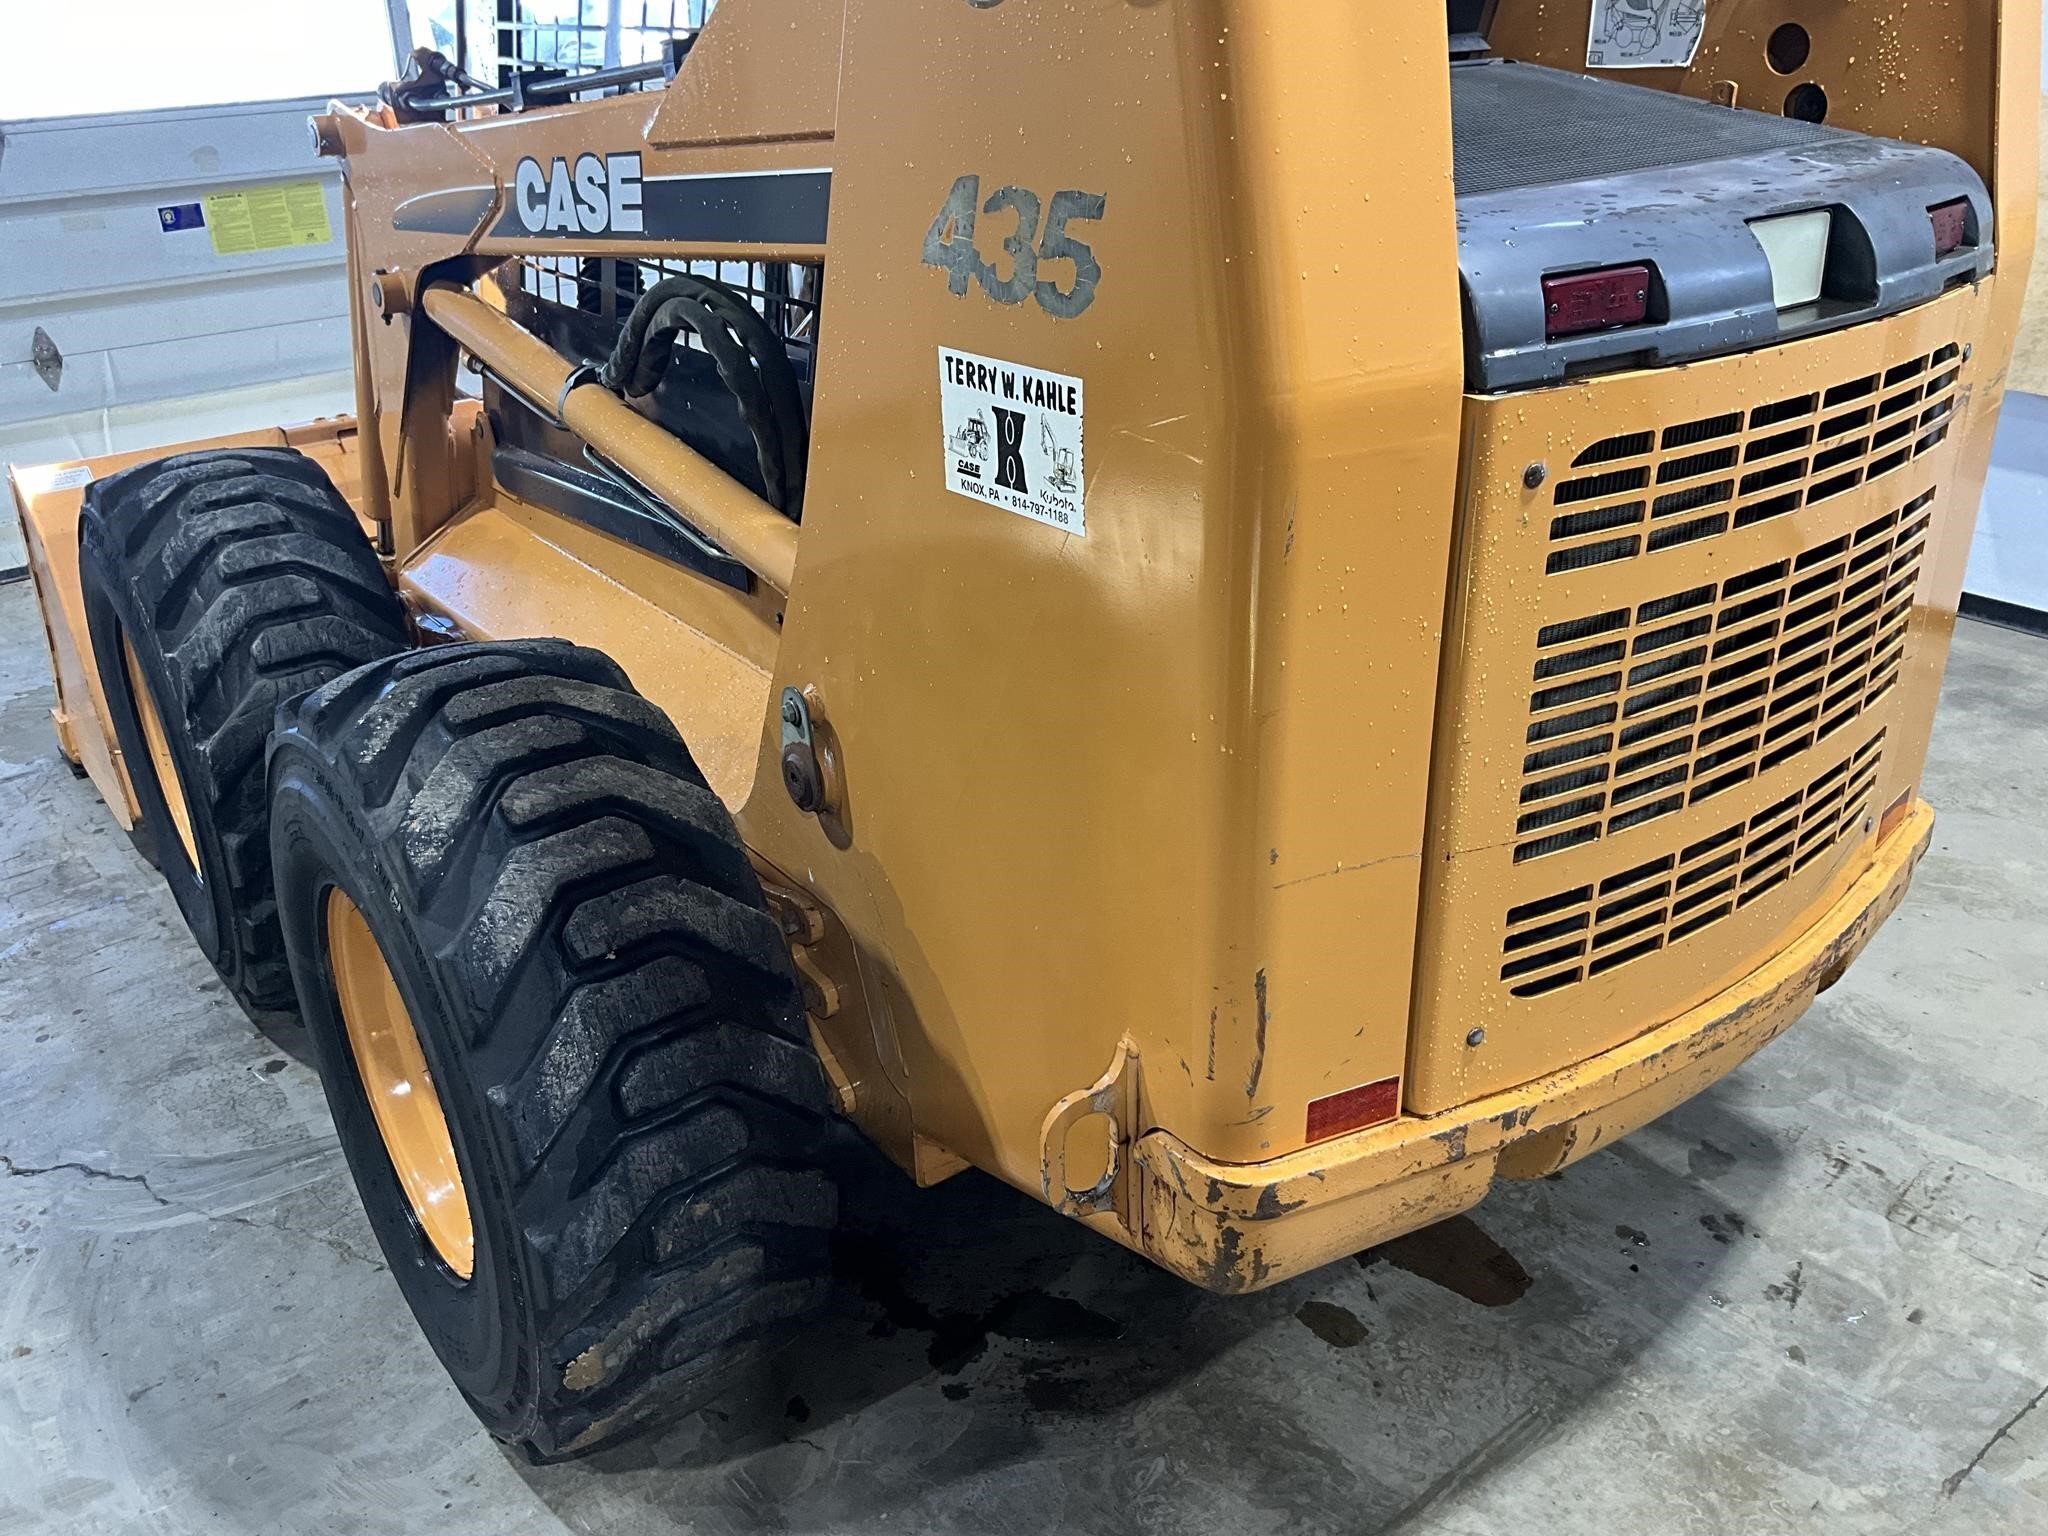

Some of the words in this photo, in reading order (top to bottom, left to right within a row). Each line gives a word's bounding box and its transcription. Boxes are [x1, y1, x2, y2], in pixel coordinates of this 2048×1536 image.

[515, 151, 643, 233] CASE
[921, 175, 1107, 319] 435
[945, 356, 997, 394] TERRY
[1002, 371, 1019, 400] W.
[1023, 375, 1077, 415] KAHLE
[958, 459, 981, 473] CASE
[961, 479, 988, 499] KNOX,
[989, 487, 1000, 501] PA
[1012, 496, 1069, 525] 814-797-1188
